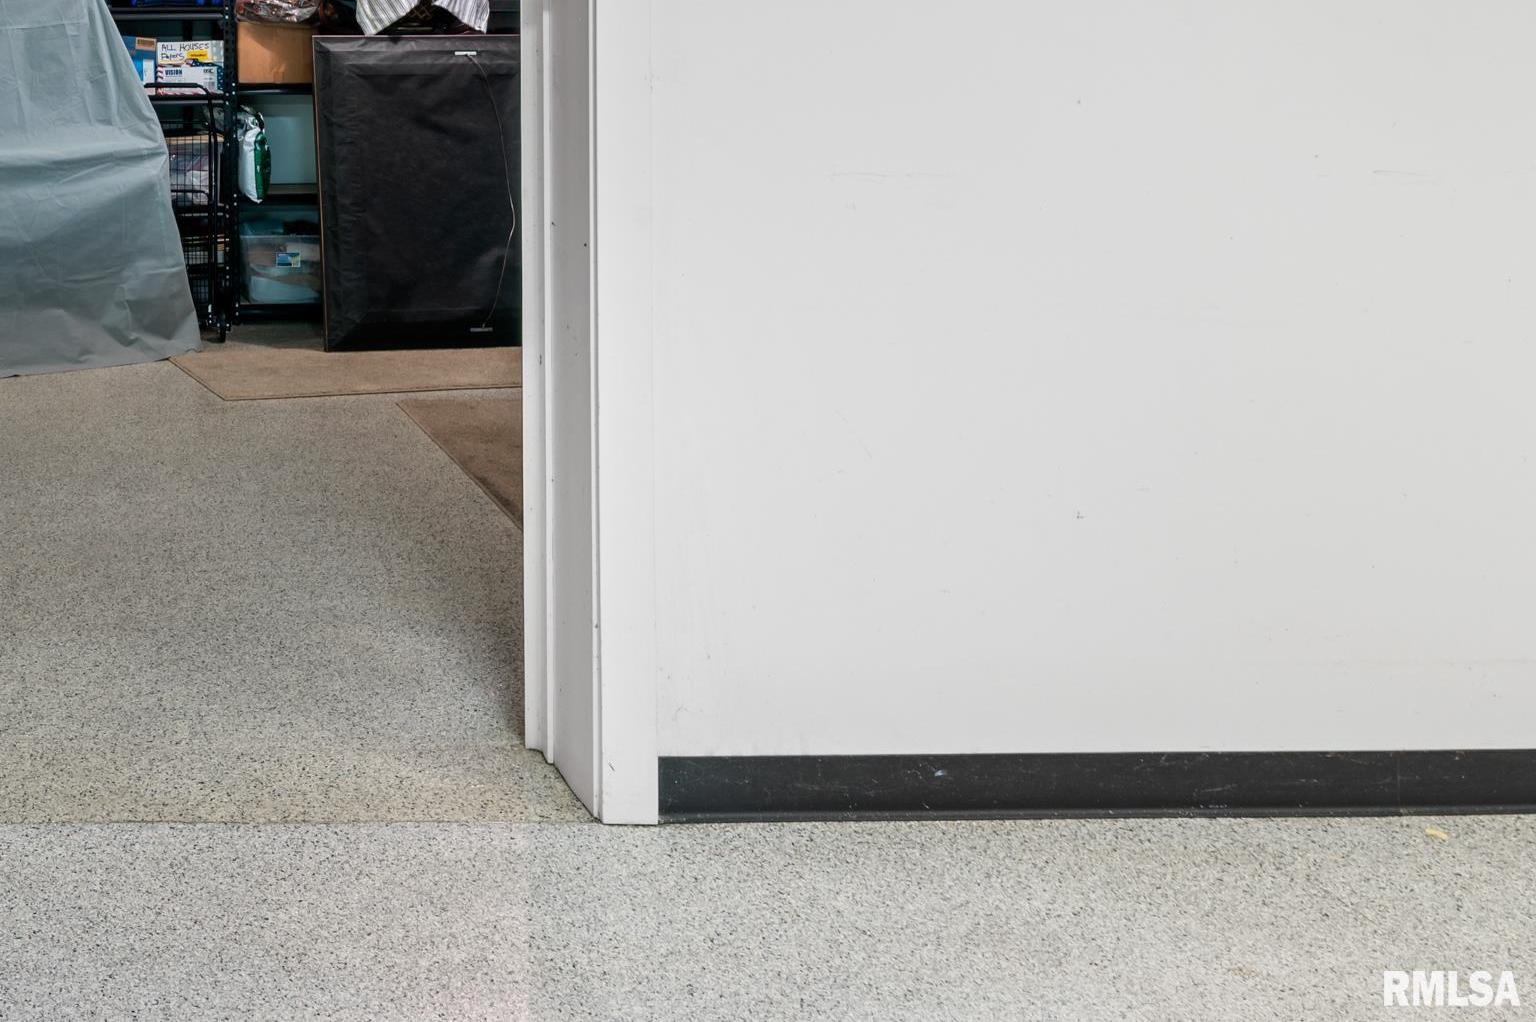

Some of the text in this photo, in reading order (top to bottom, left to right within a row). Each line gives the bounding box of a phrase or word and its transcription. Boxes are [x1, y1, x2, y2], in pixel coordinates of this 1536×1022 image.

[161, 42, 210, 52] ALL HOUSES
[165, 68, 183, 76] VISION
